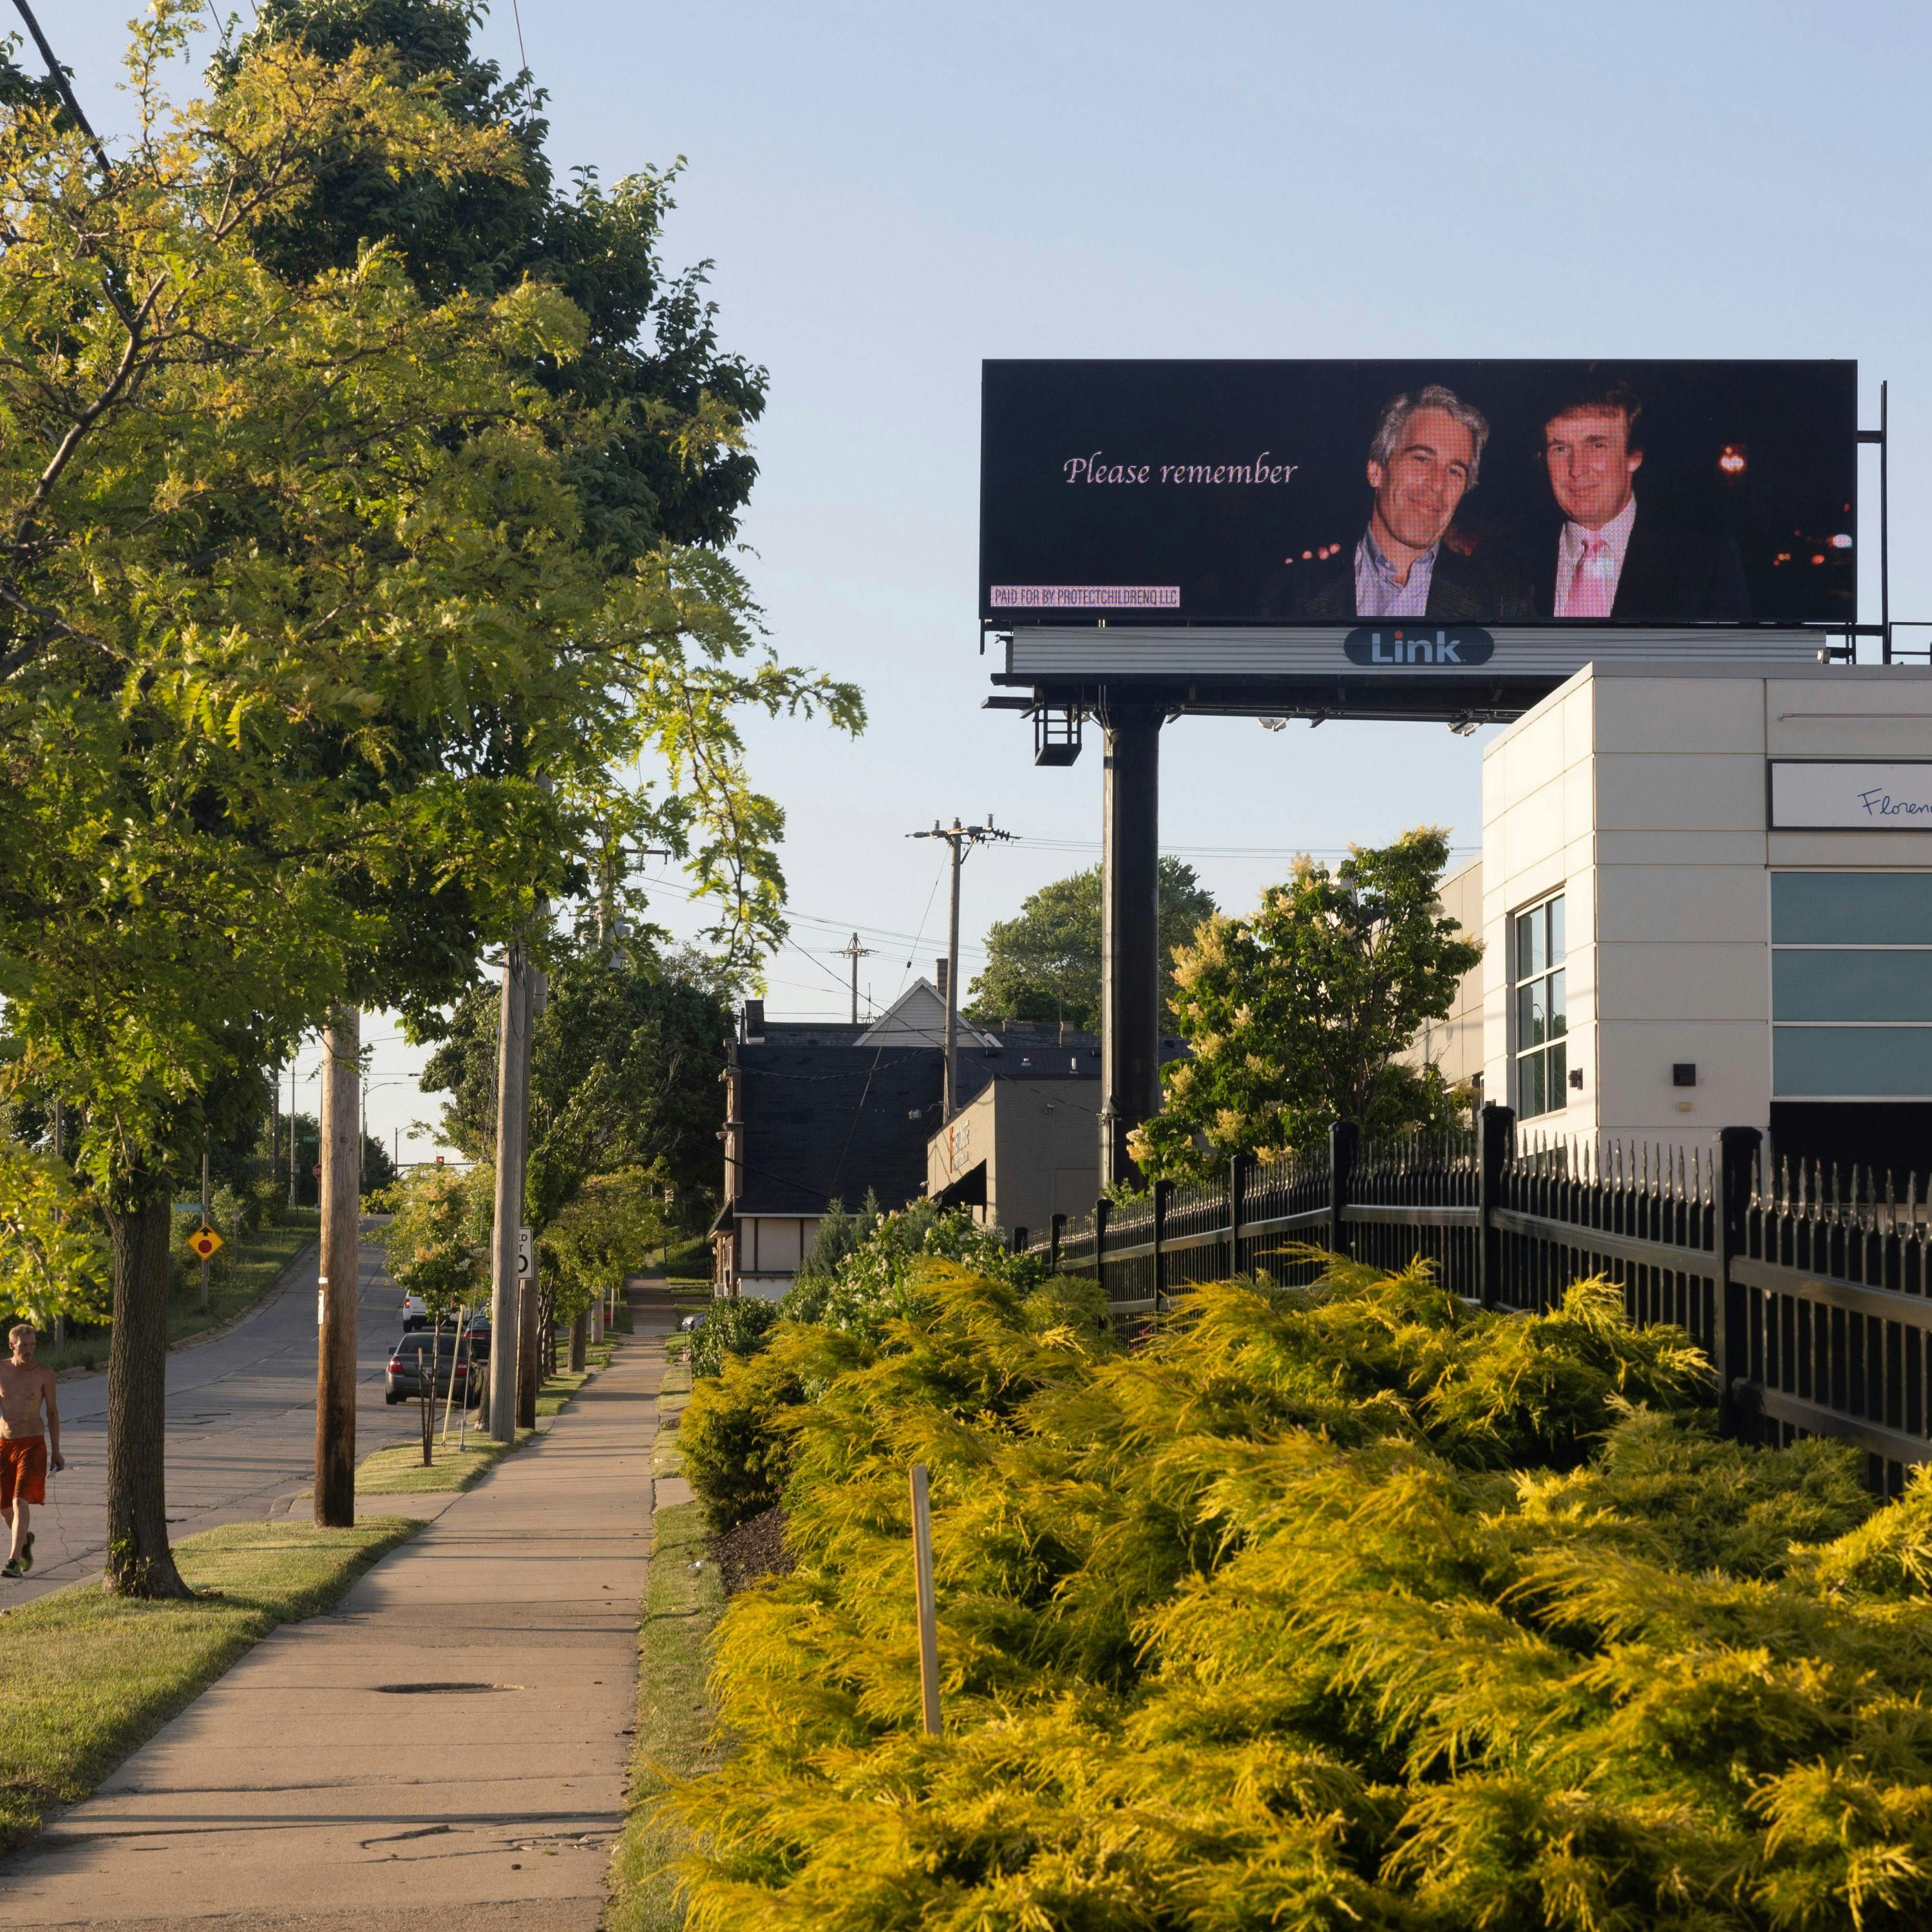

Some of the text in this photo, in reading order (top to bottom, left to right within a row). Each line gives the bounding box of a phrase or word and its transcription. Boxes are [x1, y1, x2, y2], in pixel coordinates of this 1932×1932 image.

[1063, 451, 1298, 484] Please remember
[995, 589, 1018, 604] PAID
[1021, 589, 1039, 604] FOR
[1043, 589, 1055, 604] BY
[1160, 589, 1177, 605] LLC
[1372, 630, 1461, 663] Link
[1857, 788, 1932, 816] Floren
